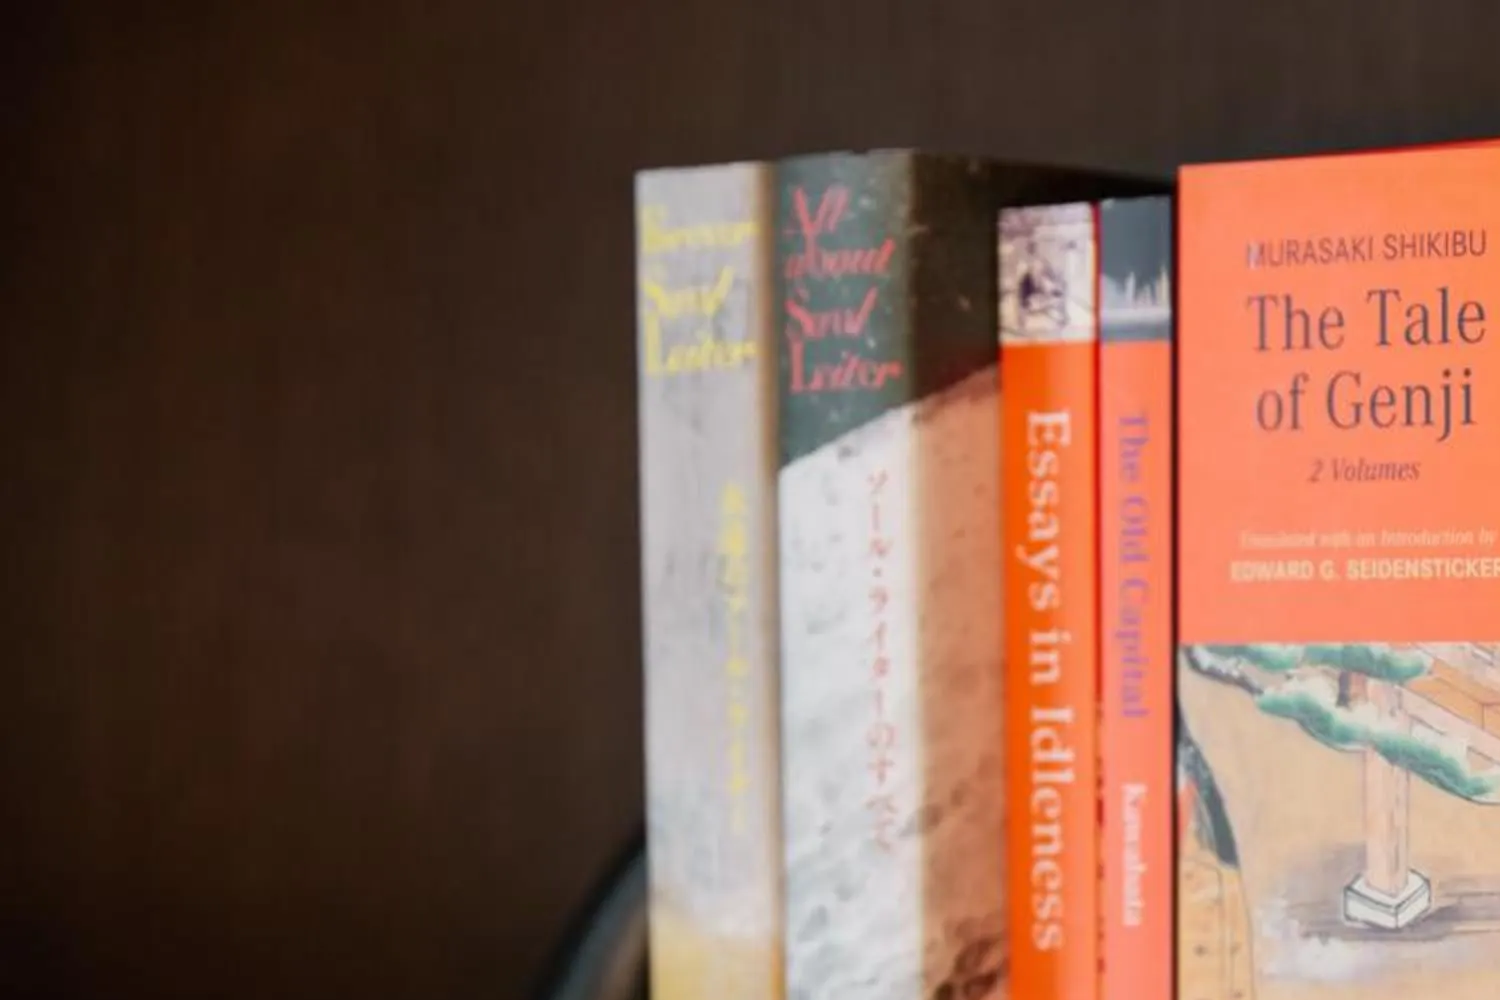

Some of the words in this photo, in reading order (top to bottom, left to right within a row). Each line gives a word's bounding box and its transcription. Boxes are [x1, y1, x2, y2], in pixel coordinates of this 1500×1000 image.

[1246, 237, 1374, 269] MURASAKI
[1382, 230, 1488, 261] SHIKIBU
[1246, 295, 1346, 352] The
[1366, 286, 1487, 348] Tale
[1255, 373, 1311, 433] of
[1325, 368, 1477, 443] Genji
[1117, 413, 1150, 484] The
[1307, 460, 1323, 483] 2
[1330, 458, 1422, 482] Volumes
[1014, 410, 1072, 611] Essays
[1118, 494, 1151, 564] Old
[1231, 560, 1315, 582] EDWARD
[1027, 627, 1073, 686] in
[1114, 577, 1152, 718] Capital
[1028, 705, 1075, 951] Idleness
